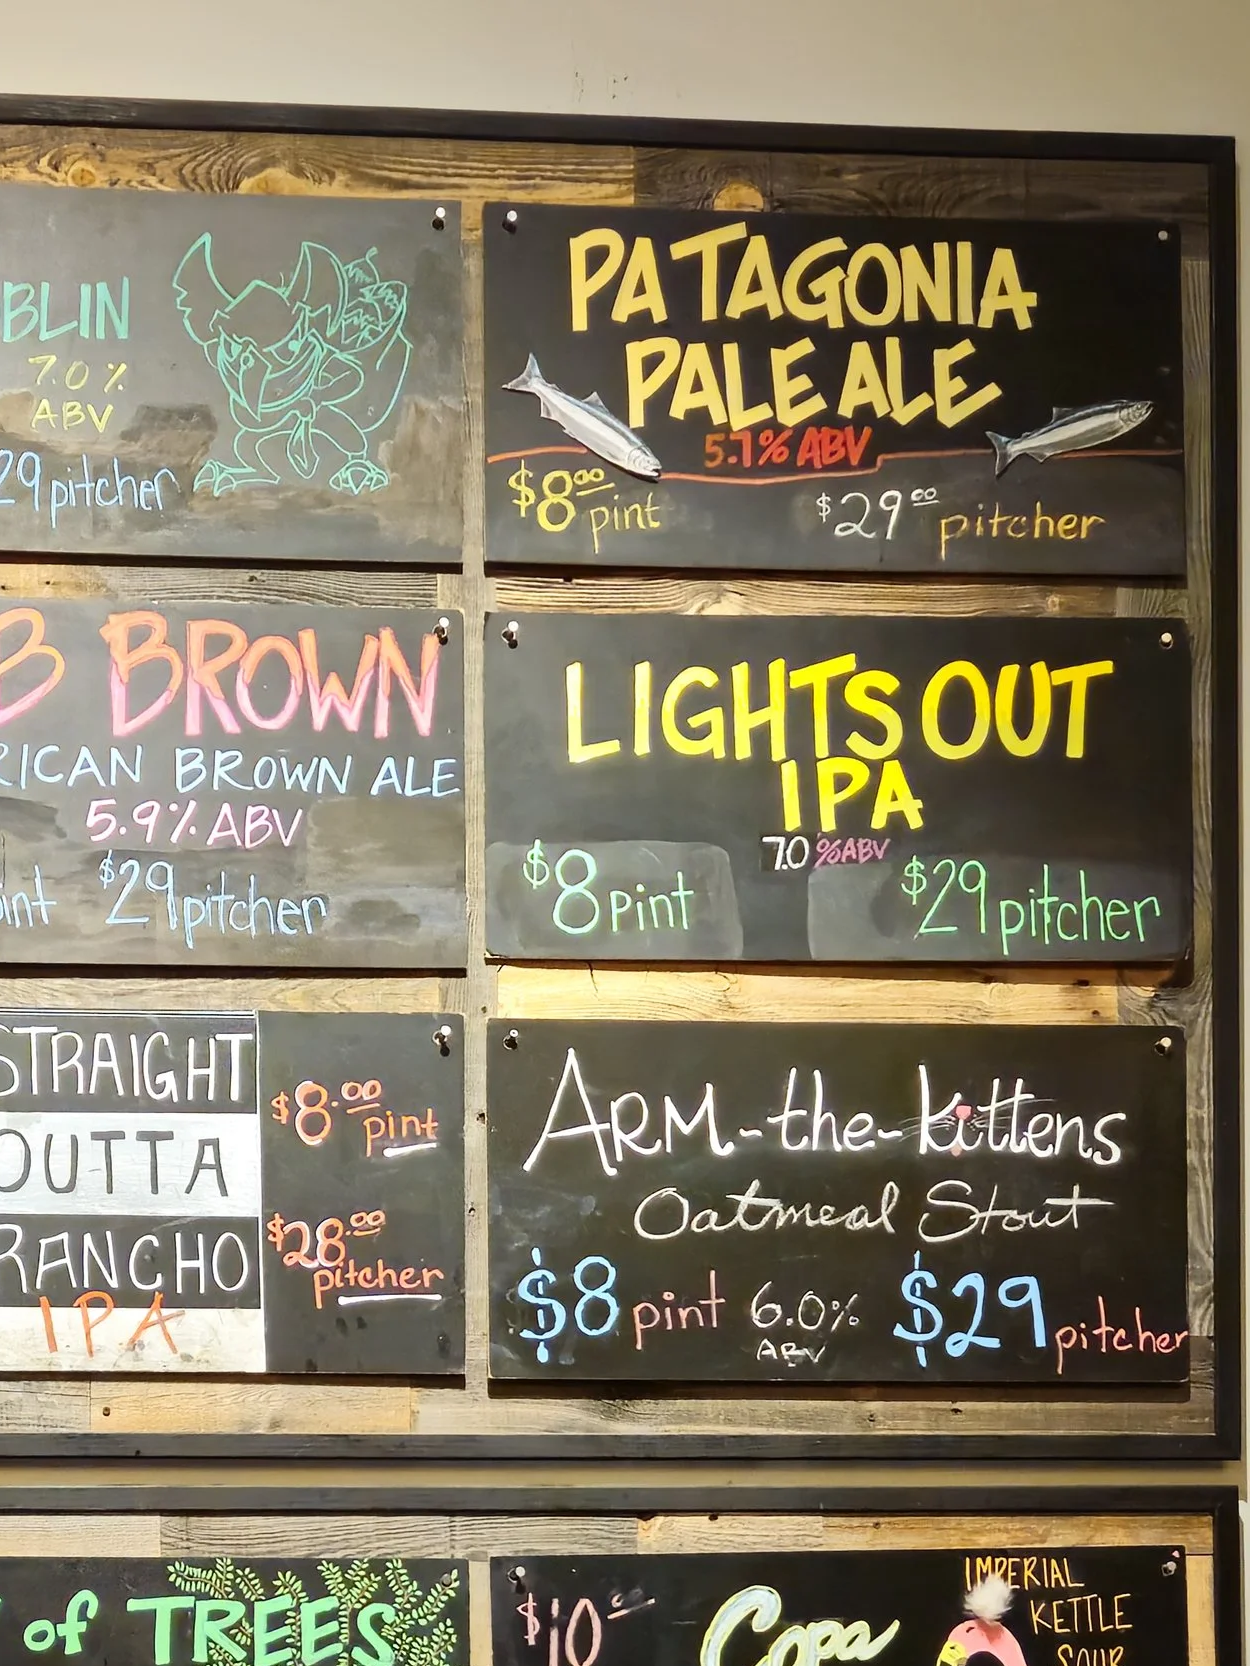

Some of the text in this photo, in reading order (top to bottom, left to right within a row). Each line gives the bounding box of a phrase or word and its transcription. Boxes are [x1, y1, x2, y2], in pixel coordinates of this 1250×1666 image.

[31, 399, 114, 433] ABV
[625, 335, 1003, 433] PALE ALE
[797, 425, 872, 469] ABV
[50, 451, 181, 529] pitcher
[589, 494, 1106, 560] pint pitcher
[99, 609, 442, 740] BROWN
[920, 658, 1115, 761] OUT
[174, 748, 353, 796] BROWN
[370, 757, 460, 798] ALE
[780, 757, 924, 833] IPA
[208, 802, 304, 848] ABV
[99, 850, 177, 930] $29
[182, 875, 327, 949] pitcher
[522, 839, 1164, 957] $8 $29 pitcher
[363, 1108, 440, 1157] pint
[634, 1179, 1117, 1244] Oatmeal Stout
[313, 1258, 445, 1309] pitcher
[517, 1247, 619, 1364] $8
[633, 1270, 726, 1351] pint
[893, 1250, 1048, 1368] $29
[1054, 1304, 1190, 1375] pitcher
[38, 1291, 187, 1359] IPA
[23, 1590, 97, 1654] of
[1030, 1593, 1133, 1635] KETTLE
